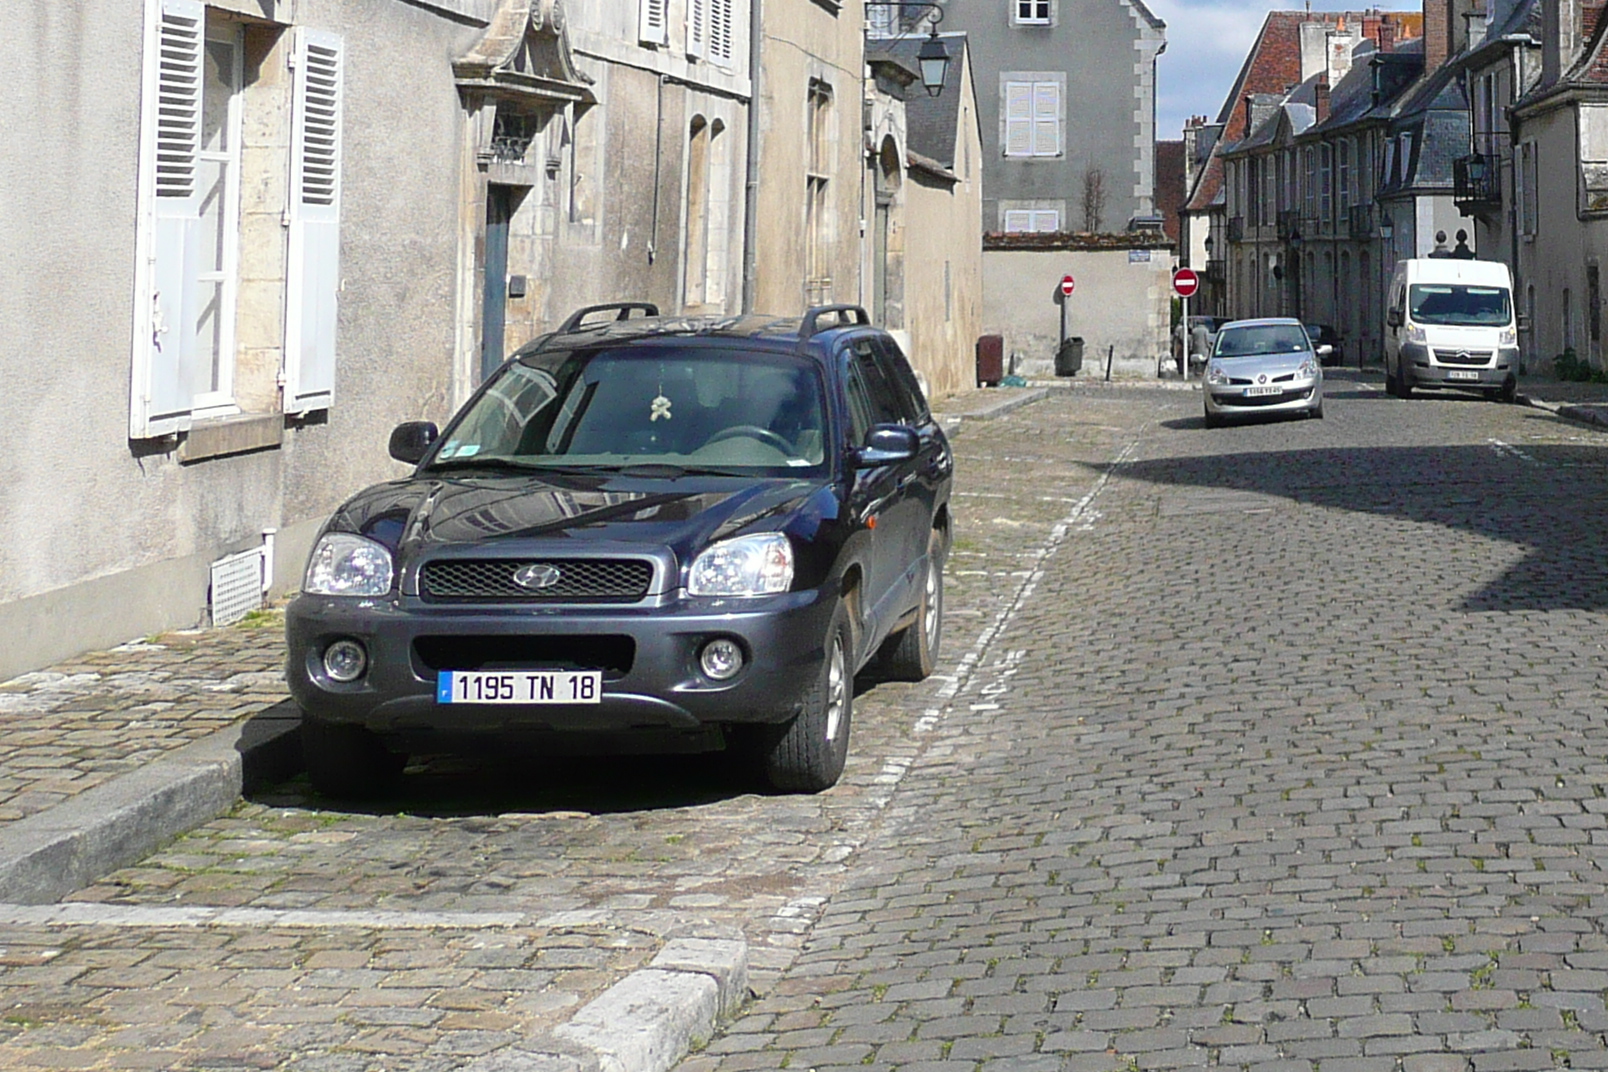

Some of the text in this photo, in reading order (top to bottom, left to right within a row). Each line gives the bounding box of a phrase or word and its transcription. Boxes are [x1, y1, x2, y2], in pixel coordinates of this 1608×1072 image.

[459, 675, 595, 700] 1195 TN 18
